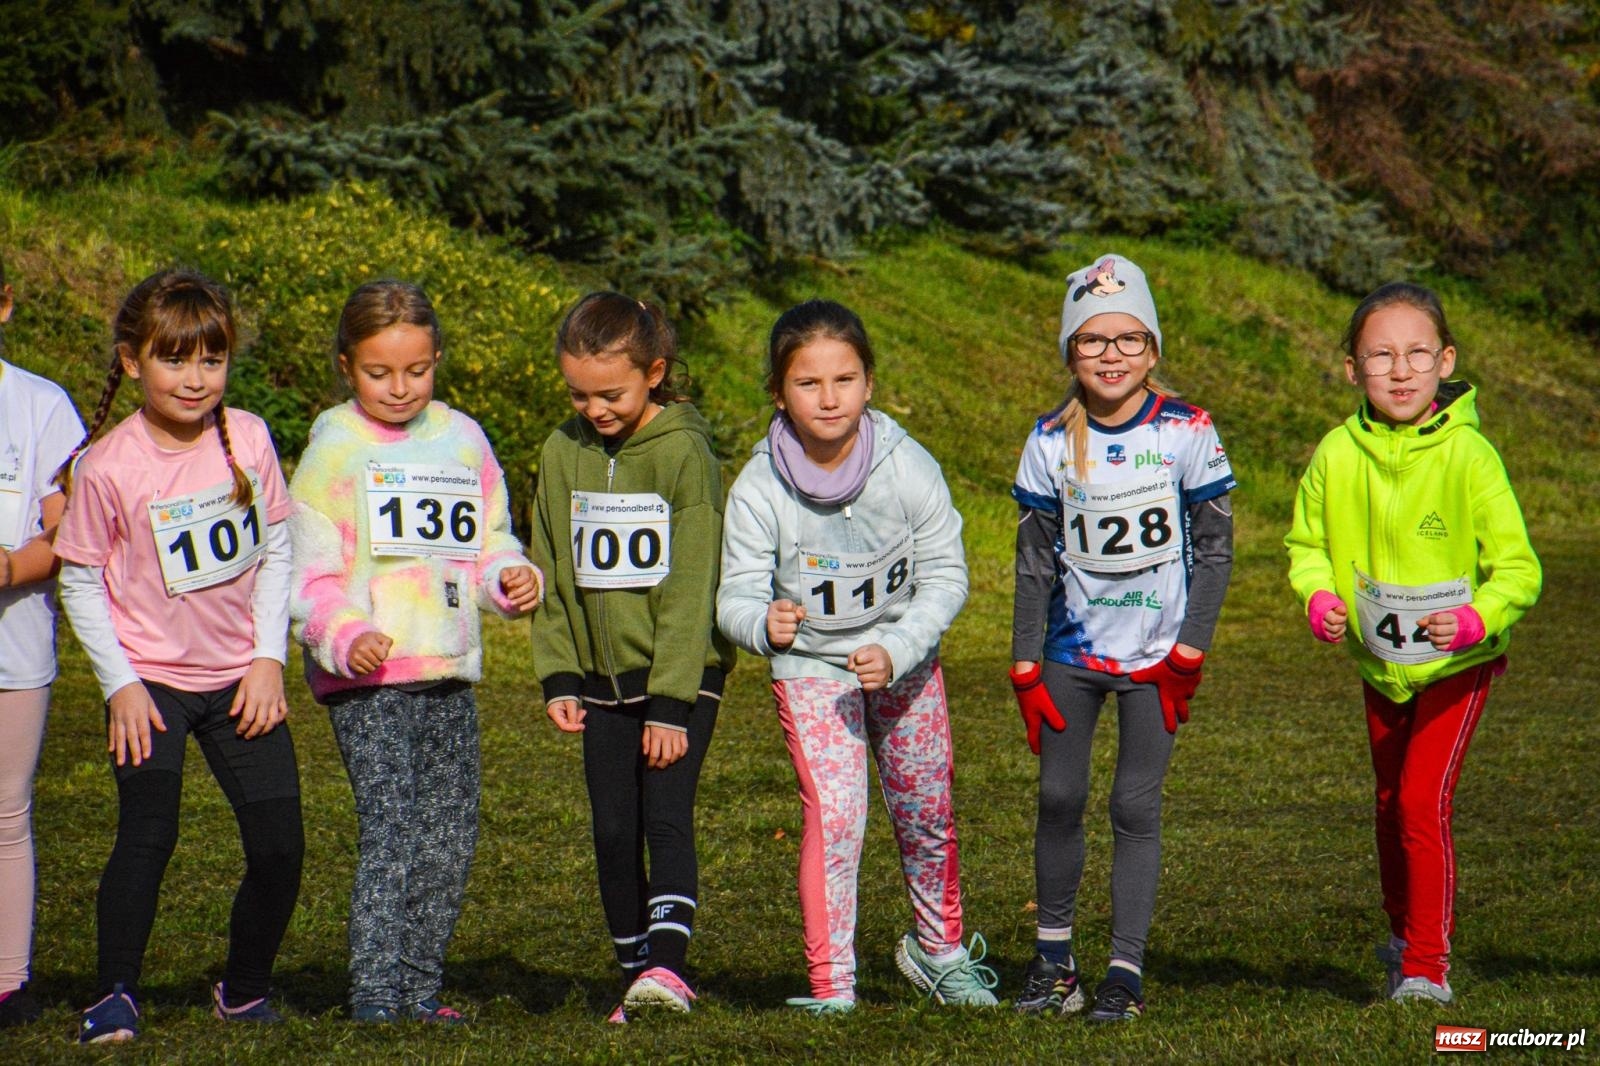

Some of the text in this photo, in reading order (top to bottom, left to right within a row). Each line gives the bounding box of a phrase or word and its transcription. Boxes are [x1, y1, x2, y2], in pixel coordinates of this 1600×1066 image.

[412, 474, 478, 485] www.personalbest.pl
[1091, 480, 1167, 502] www.personalbest.pl
[379, 497, 476, 543] 136
[1070, 507, 1172, 555] 128
[169, 504, 260, 572] 101
[574, 527, 660, 570] 100
[812, 557, 908, 615] 118
[1123, 591, 1143, 600] AIR
[1386, 587, 1466, 602] www.personalbest.pl
[651, 904, 674, 919] 4F
